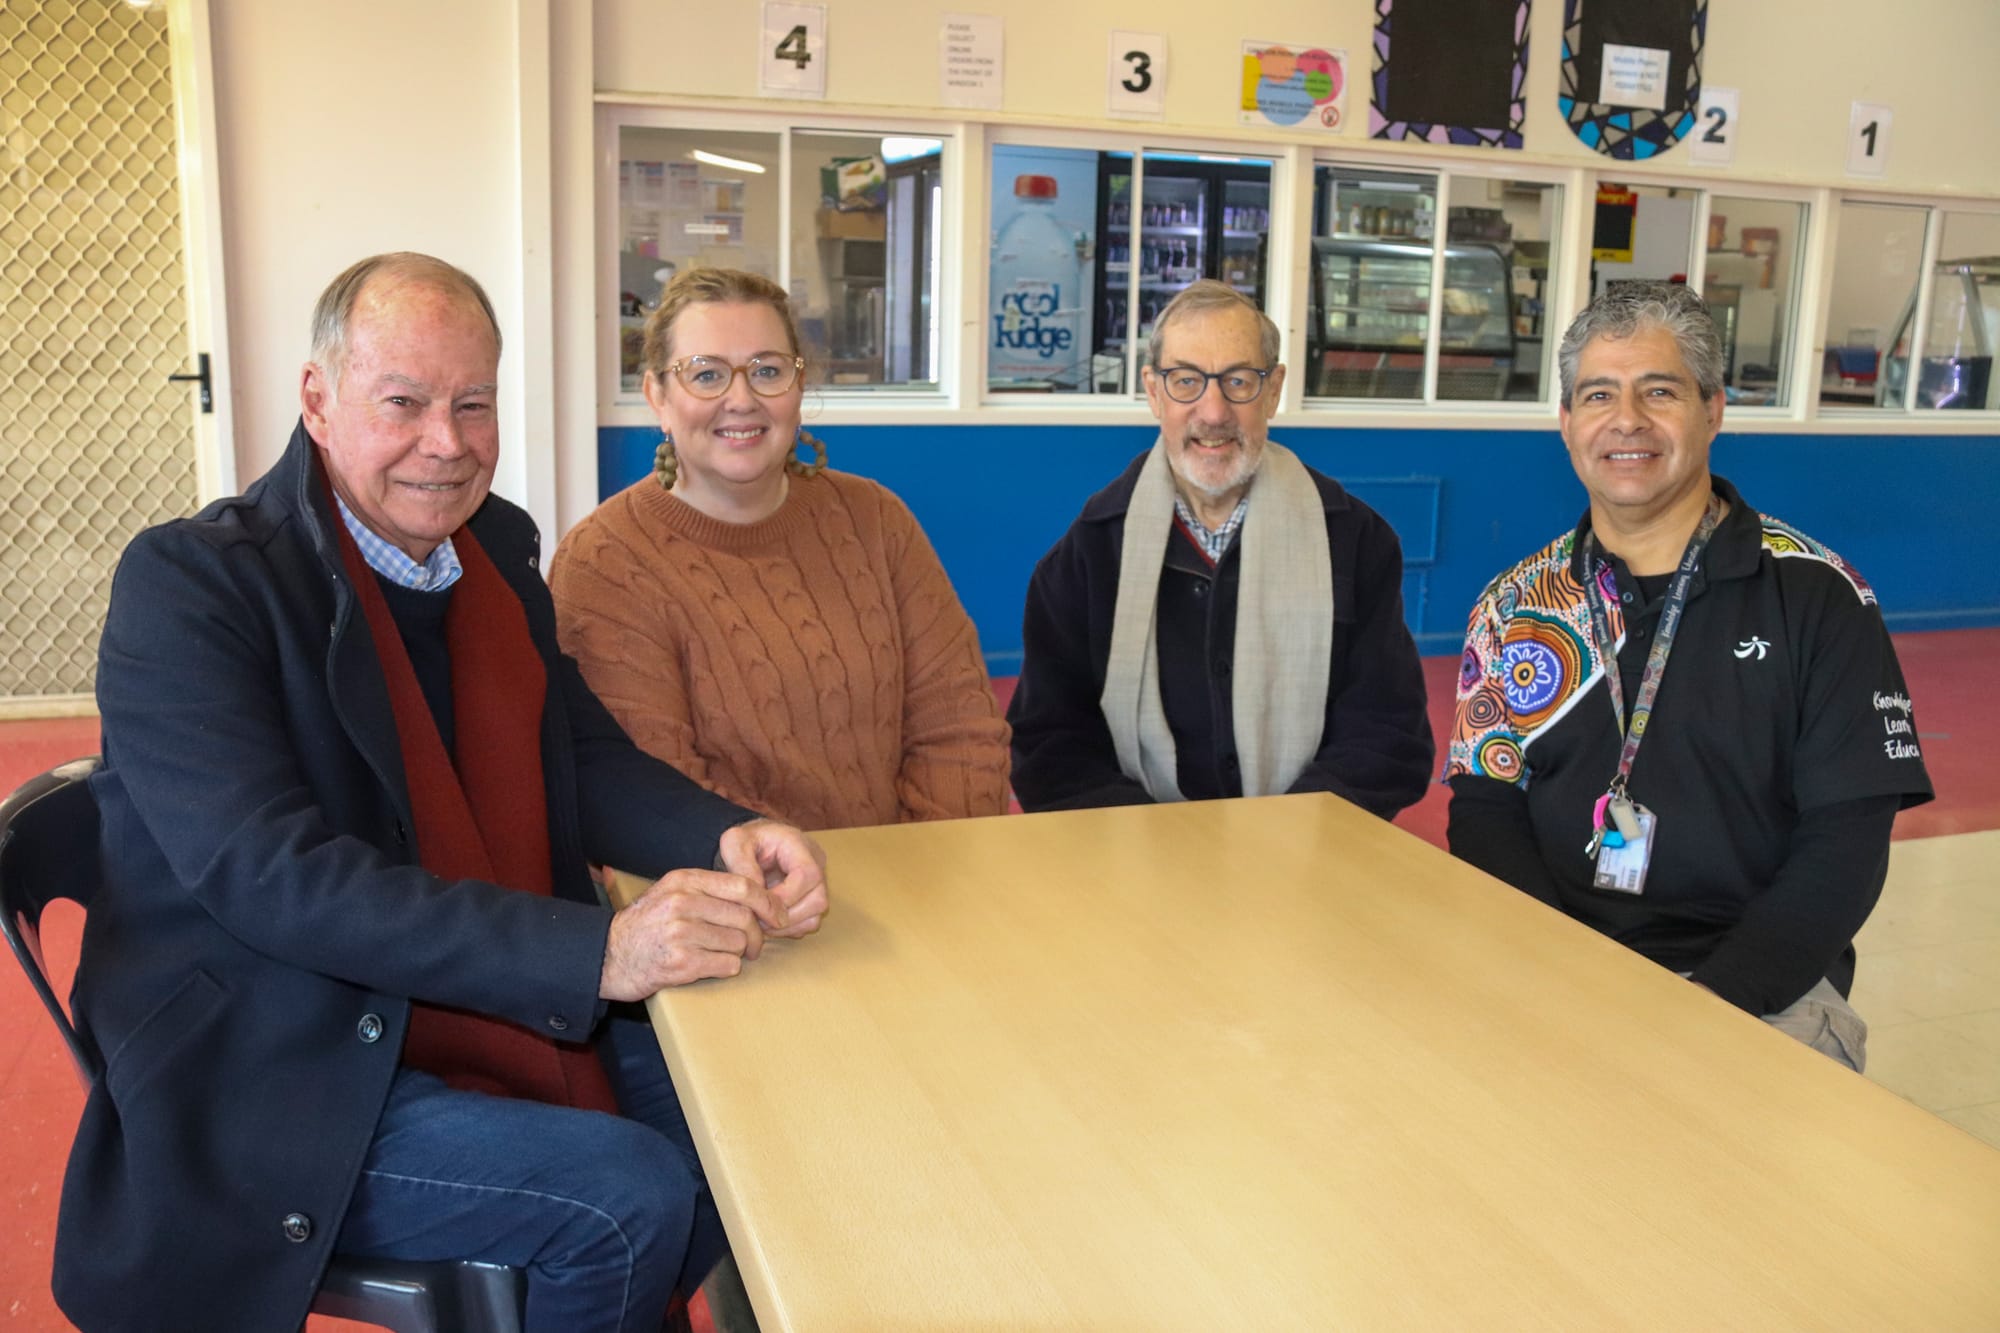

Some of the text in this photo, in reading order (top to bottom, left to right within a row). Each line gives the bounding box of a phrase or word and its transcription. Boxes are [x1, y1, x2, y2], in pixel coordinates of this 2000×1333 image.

[775, 25, 811, 69] 4
[1122, 51, 1152, 93] 3
[1703, 107, 1727, 143] 2
[1861, 121, 1877, 156] 1
